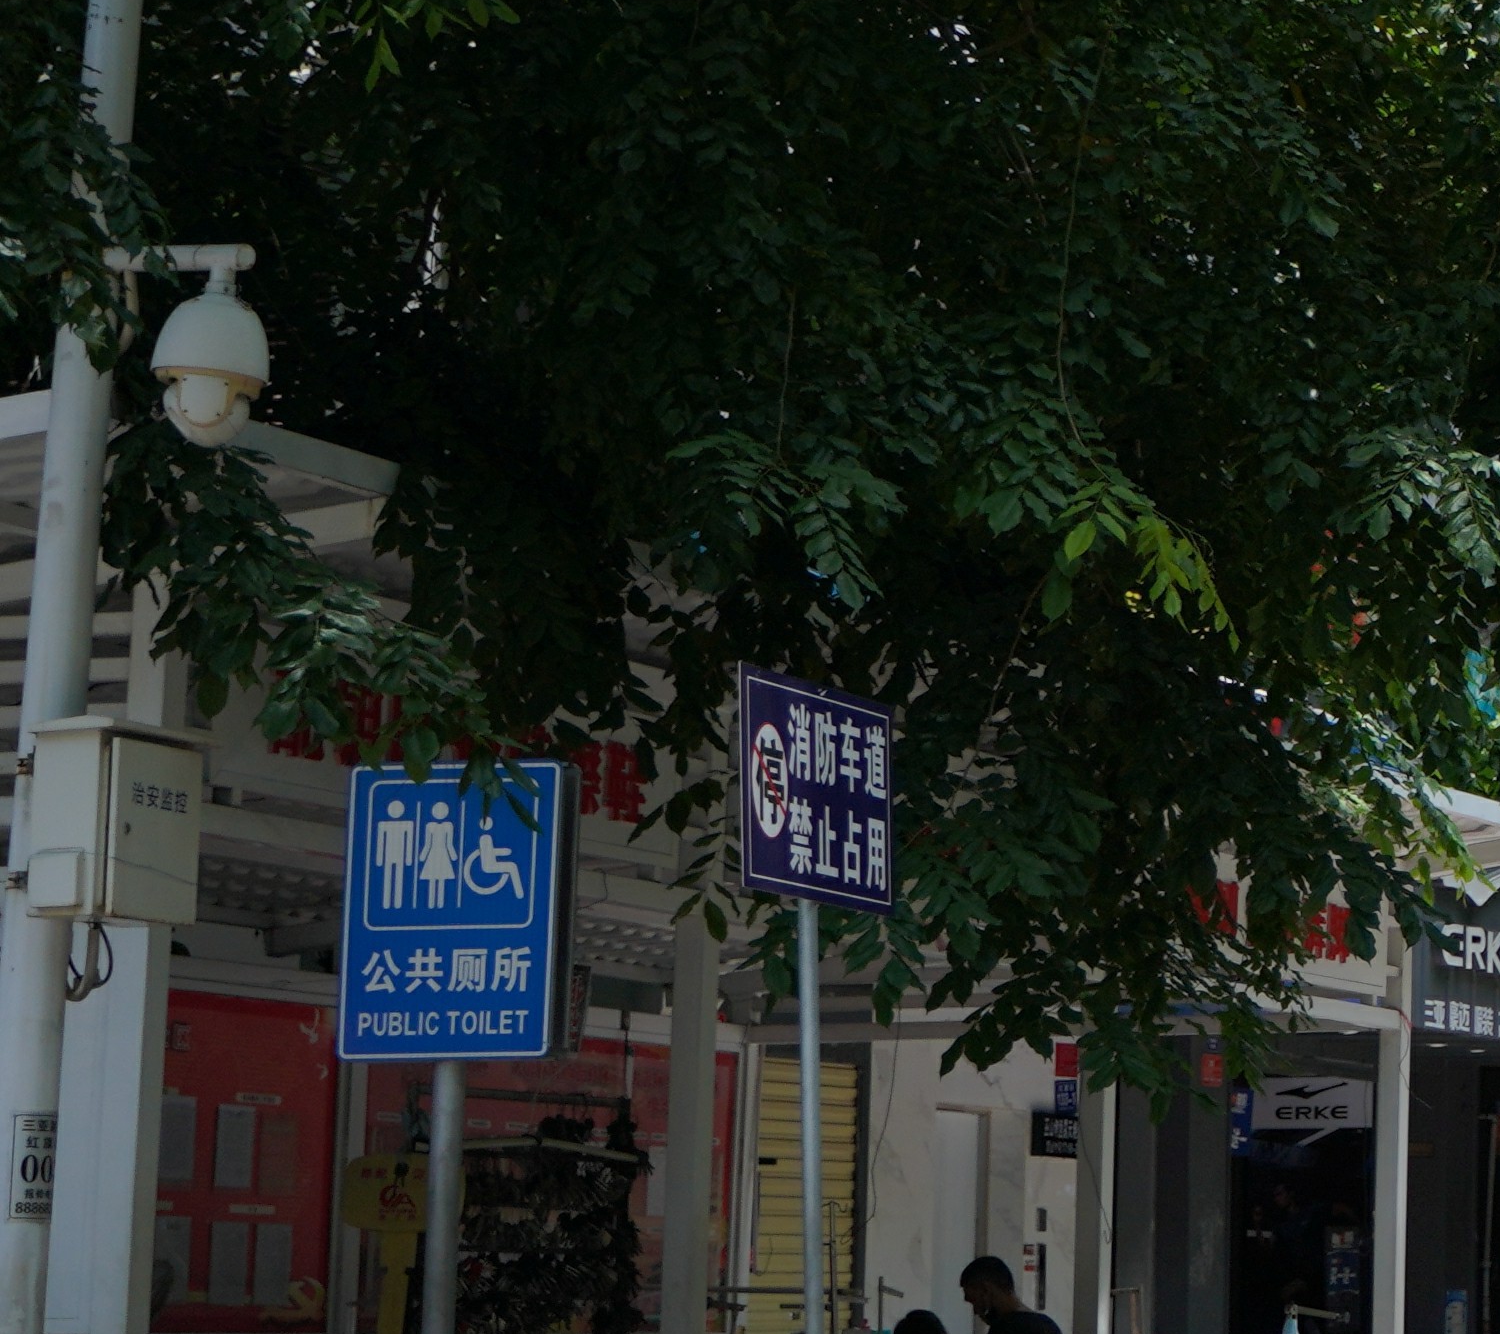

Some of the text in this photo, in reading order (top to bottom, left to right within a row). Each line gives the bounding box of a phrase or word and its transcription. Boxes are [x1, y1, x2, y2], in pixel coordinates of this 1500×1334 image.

[787, 702, 887, 800] 消防车道
[132, 781, 188, 814] 治安监控
[788, 794, 886, 892] 禁止占用
[361, 946, 532, 994] 公共厕所
[357, 1009, 530, 1037] PUBLIC TOILET
[1275, 1105, 1348, 1120] ERKE
